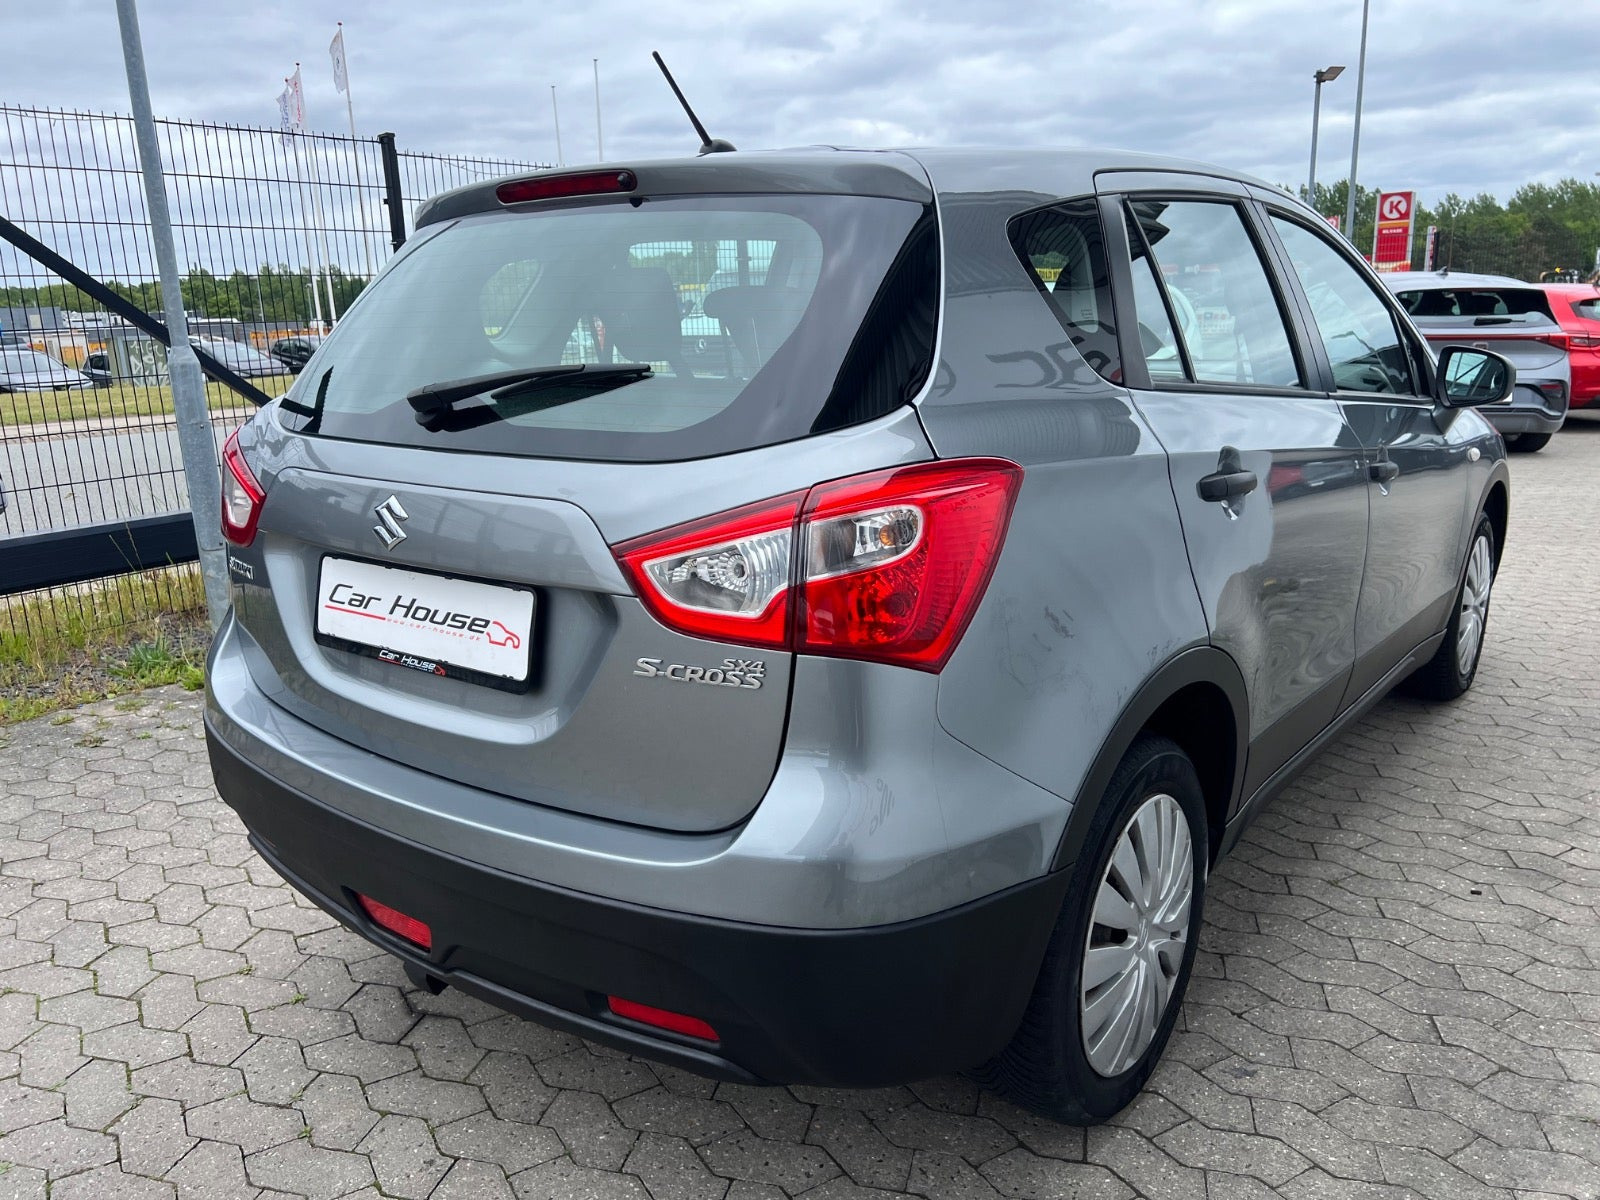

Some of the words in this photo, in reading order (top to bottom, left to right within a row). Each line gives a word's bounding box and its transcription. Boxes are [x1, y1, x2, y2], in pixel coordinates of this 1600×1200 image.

[328, 583, 381, 610] Car
[389, 595, 490, 634] House
[379, 649, 400, 660] Car
[400, 654, 436, 670] House
[720, 658, 765, 674] SX4
[633, 657, 765, 690] S-CROSS
